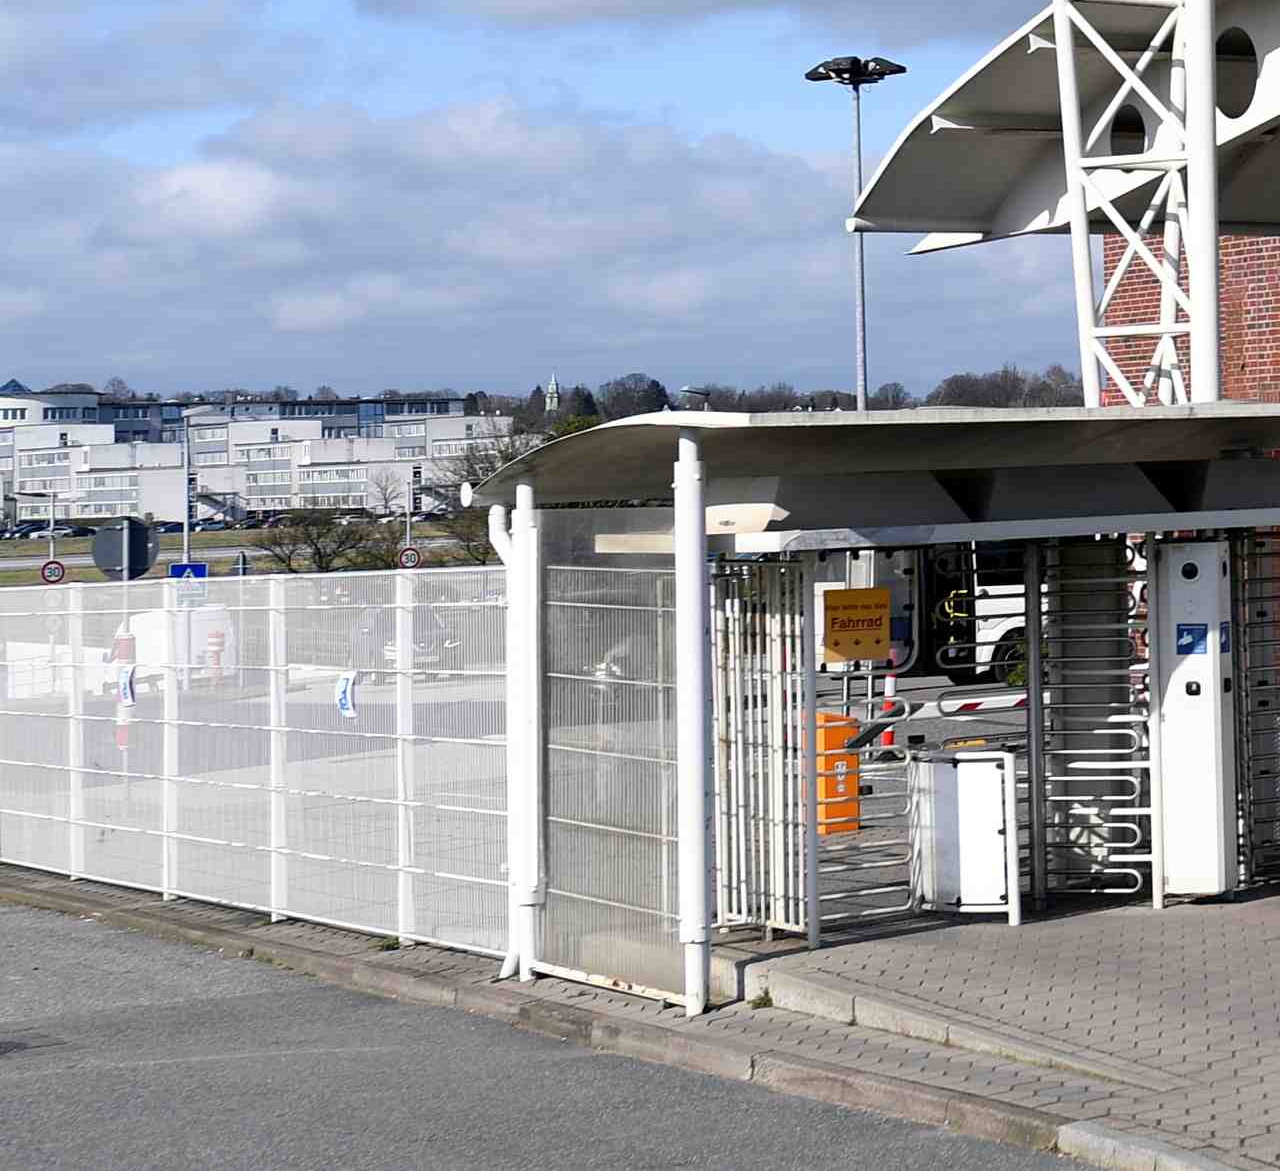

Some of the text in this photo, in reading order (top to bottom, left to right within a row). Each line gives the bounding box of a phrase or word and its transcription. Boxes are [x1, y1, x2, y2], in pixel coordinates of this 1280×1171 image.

[404, 553, 417, 564] 30
[47, 566, 60, 578] 30
[831, 615, 882, 629] Fahrrad
